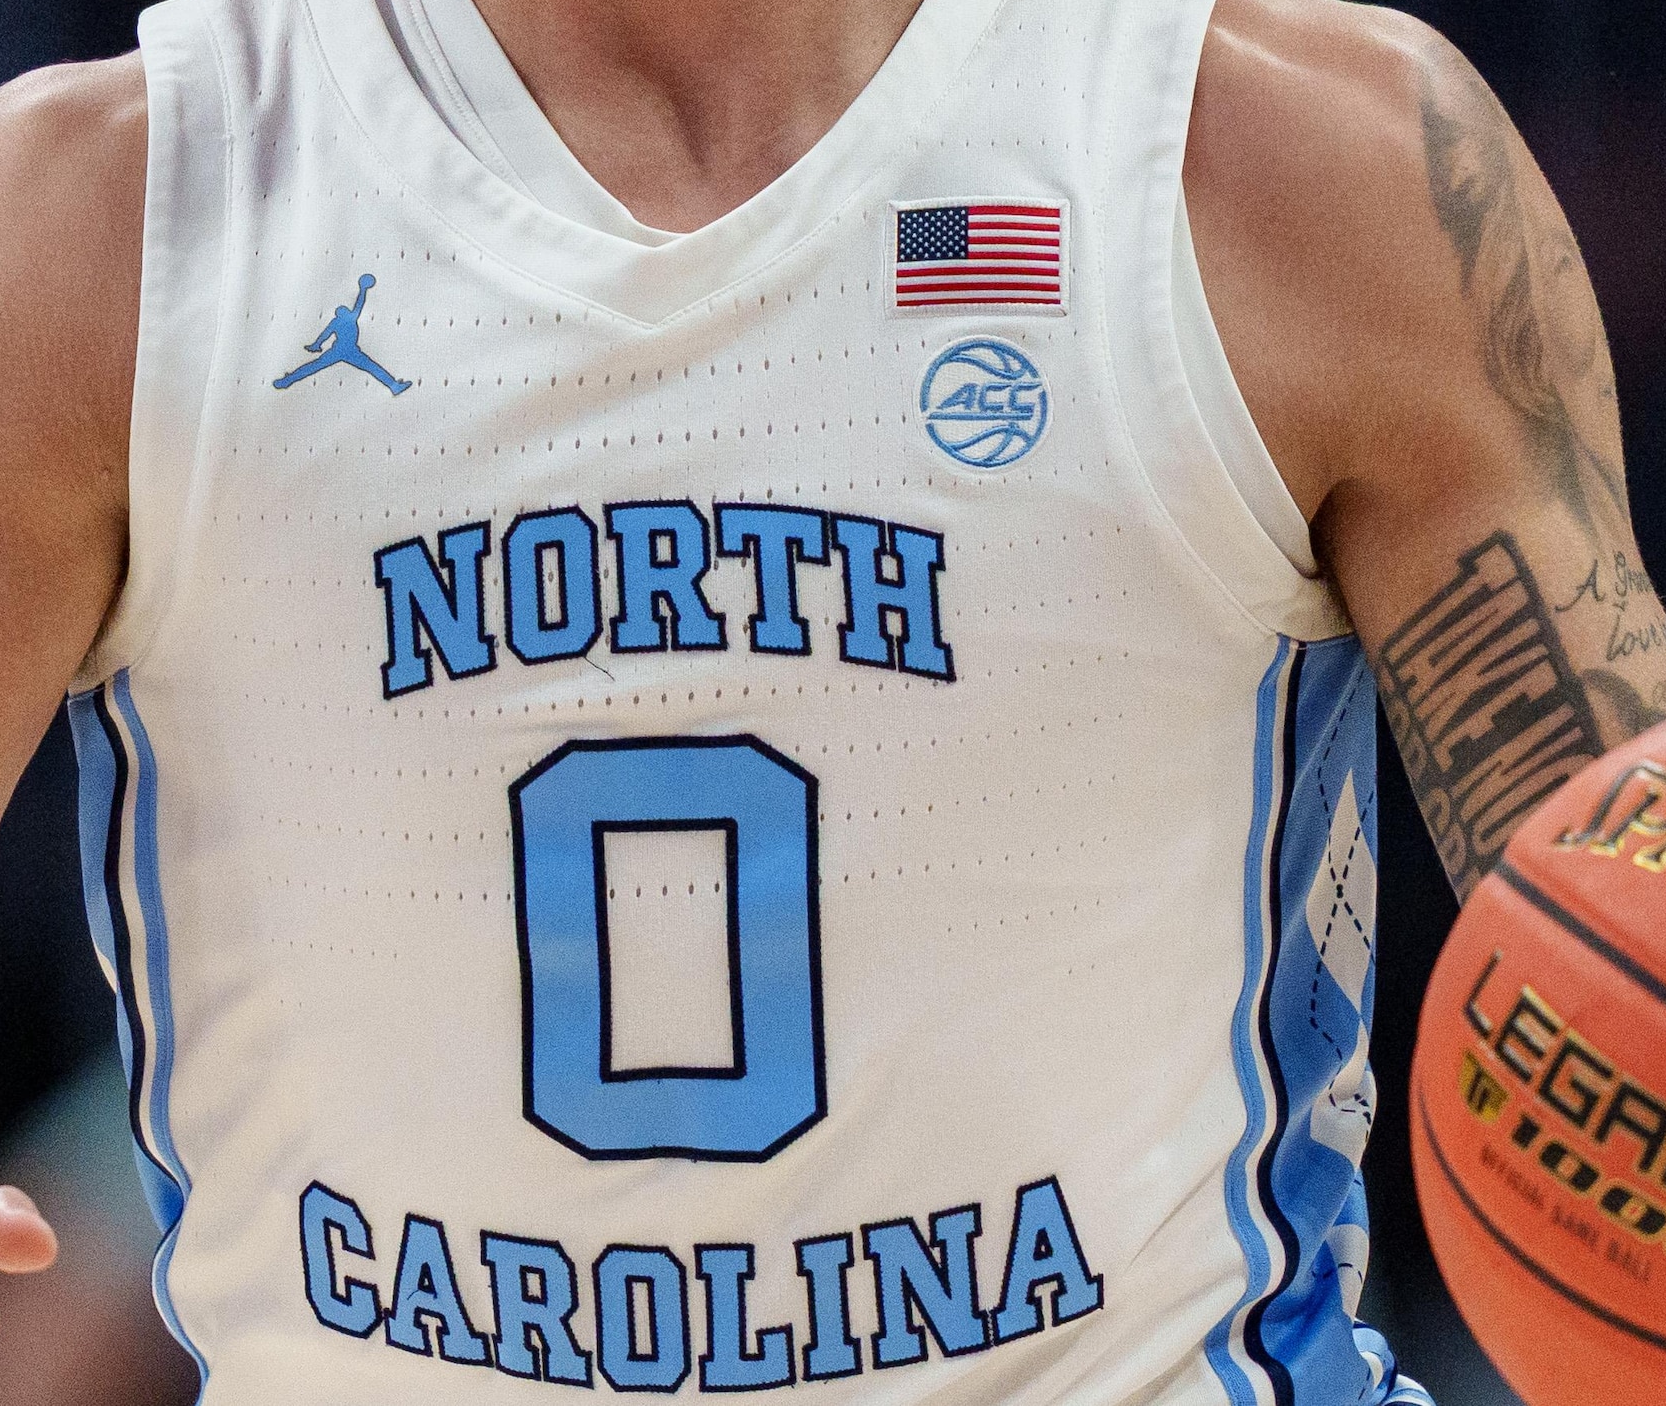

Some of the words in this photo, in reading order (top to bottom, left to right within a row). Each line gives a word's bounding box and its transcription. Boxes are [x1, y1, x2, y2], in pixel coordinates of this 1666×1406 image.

[936, 380, 1043, 413] ACC
[374, 499, 957, 700] NORTH
[1384, 538, 1562, 774] TAKE
[1554, 558, 1605, 613] A
[508, 733, 828, 1164] 0
[298, 1174, 1105, 1394] CAROLINA
